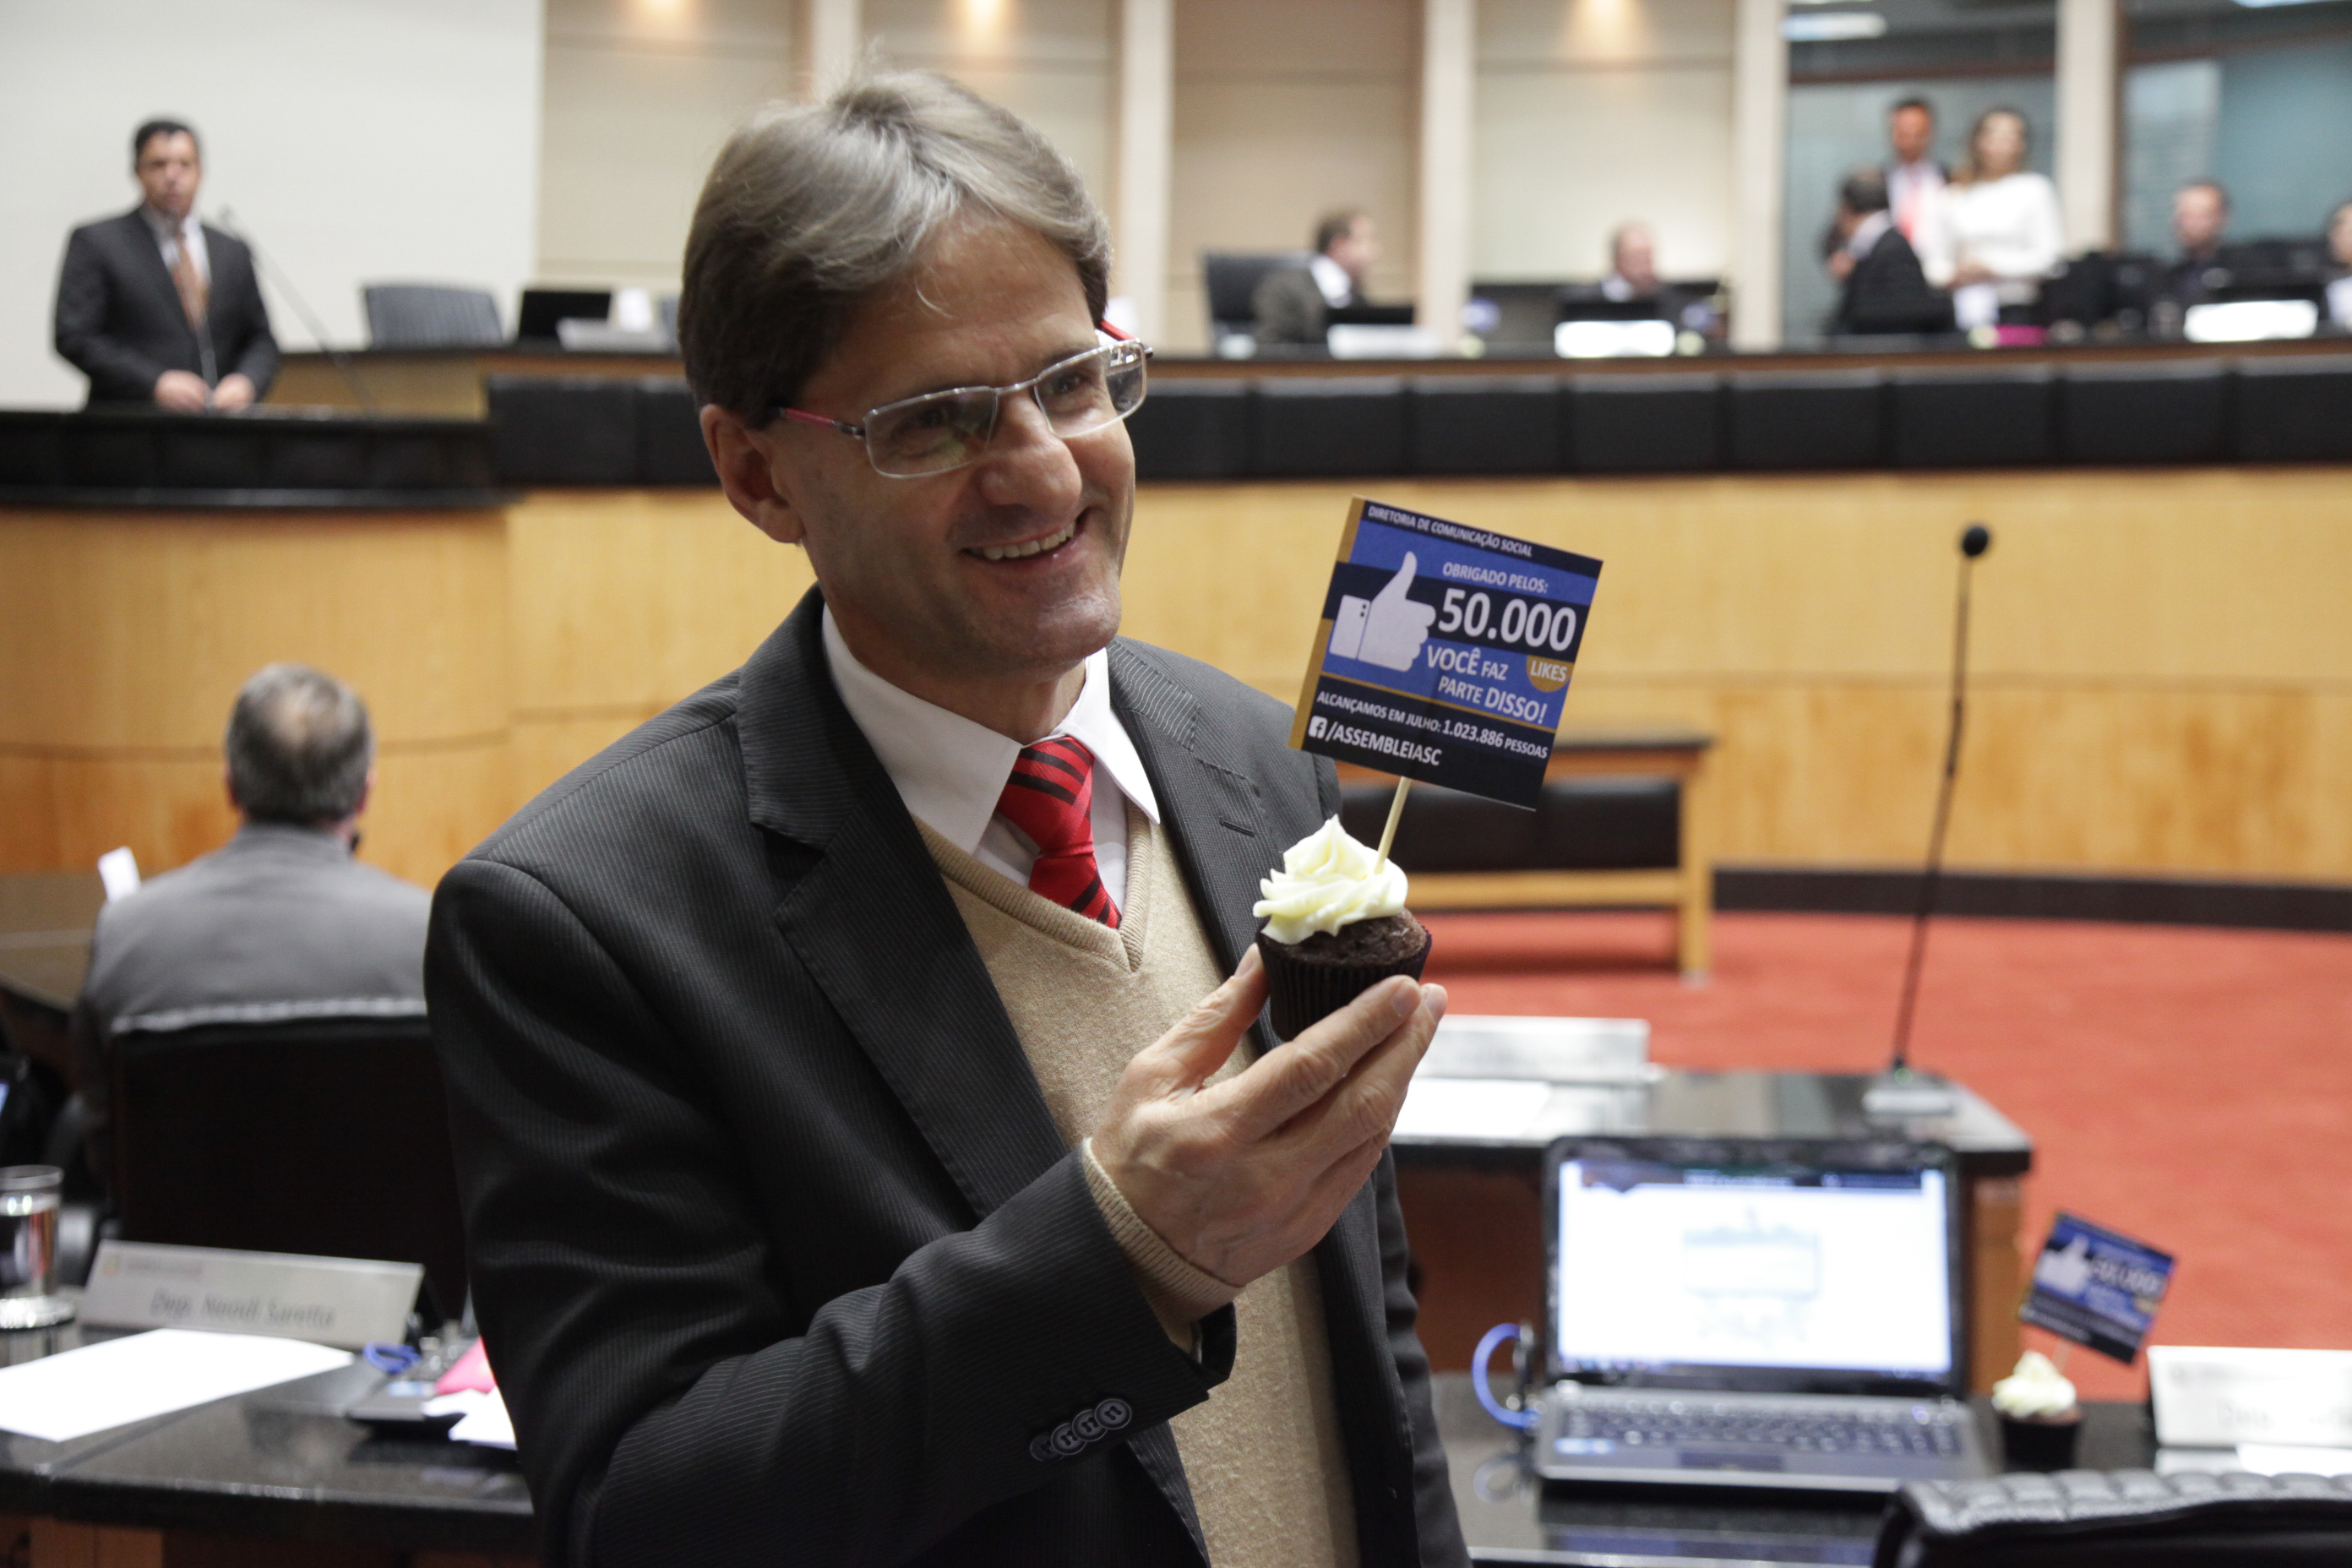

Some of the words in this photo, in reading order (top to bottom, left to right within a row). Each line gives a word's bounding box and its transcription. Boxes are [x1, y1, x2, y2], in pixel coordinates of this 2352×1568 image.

[1368, 505, 1416, 528] DIRETORIA
[1417, 518, 1429, 530] DE
[1431, 520, 1500, 549] COMUNICAÇÃO
[1501, 536, 1533, 557] SOCIAL
[1443, 562, 1506, 585] OBRIGADO
[1509, 573, 1549, 593] PELOS:
[1438, 588, 1576, 651] 50.000
[1428, 645, 1480, 675] VOCÊ
[1482, 660, 1508, 680] FAZ
[1530, 660, 1567, 683] LIKES
[1438, 676, 1483, 704] PARTE
[1484, 689, 1547, 723] DISSO!
[1316, 691, 1387, 719] ALCANÇAMOS
[1389, 708, 1405, 722] EM
[1406, 712, 1441, 732] JULHO:
[1442, 720, 1504, 747] 1.023.886
[1505, 738, 1547, 759] PESSOAS
[1326, 721, 1442, 766] /ASSEMBLEIASC
